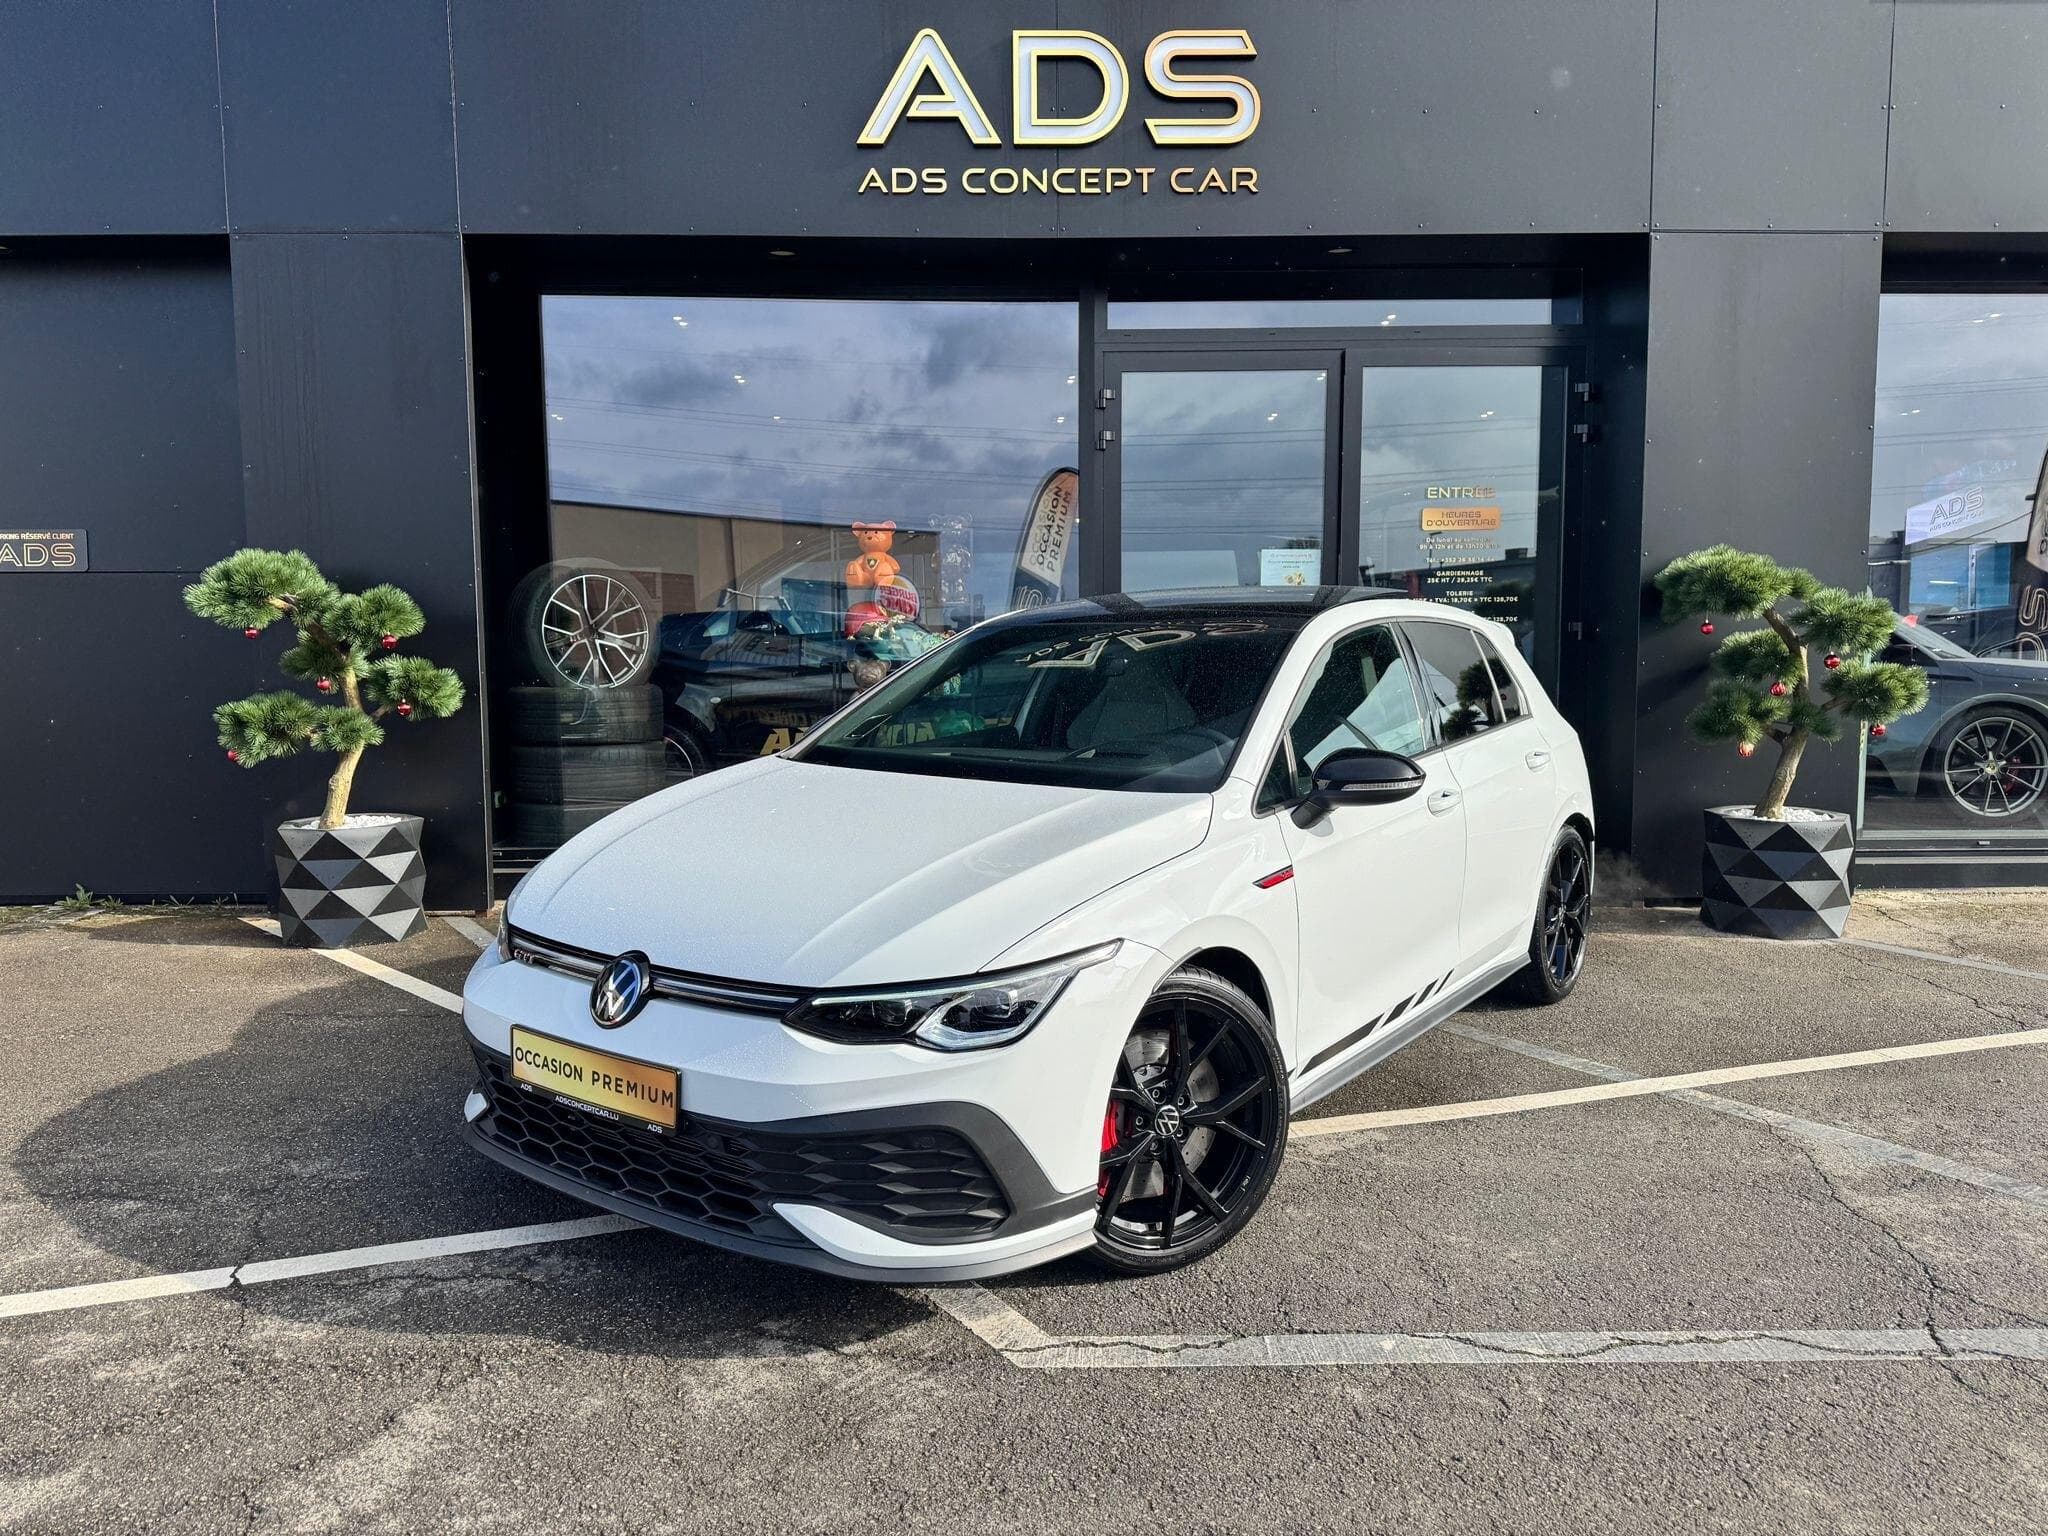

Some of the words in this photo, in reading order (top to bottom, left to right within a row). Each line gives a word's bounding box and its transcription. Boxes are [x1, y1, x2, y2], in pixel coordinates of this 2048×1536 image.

[856, 27, 1262, 146] ADS
[858, 167, 948, 193] ADS
[962, 167, 1156, 194] CONCEPT
[1170, 167, 1259, 193] CAR
[1931, 486, 1984, 526] ADS
[1037, 486, 1063, 566] OCCASION
[1047, 490, 1072, 572] PREMIUM
[0, 543, 76, 567] ADS
[515, 1046, 583, 1083] OCCASION
[591, 1070, 674, 1108] PREMIUM
[520, 1083, 533, 1092] ADS
[555, 1095, 620, 1121] ADSCONCEPTCAR.LU
[647, 1123, 663, 1134] ADS
